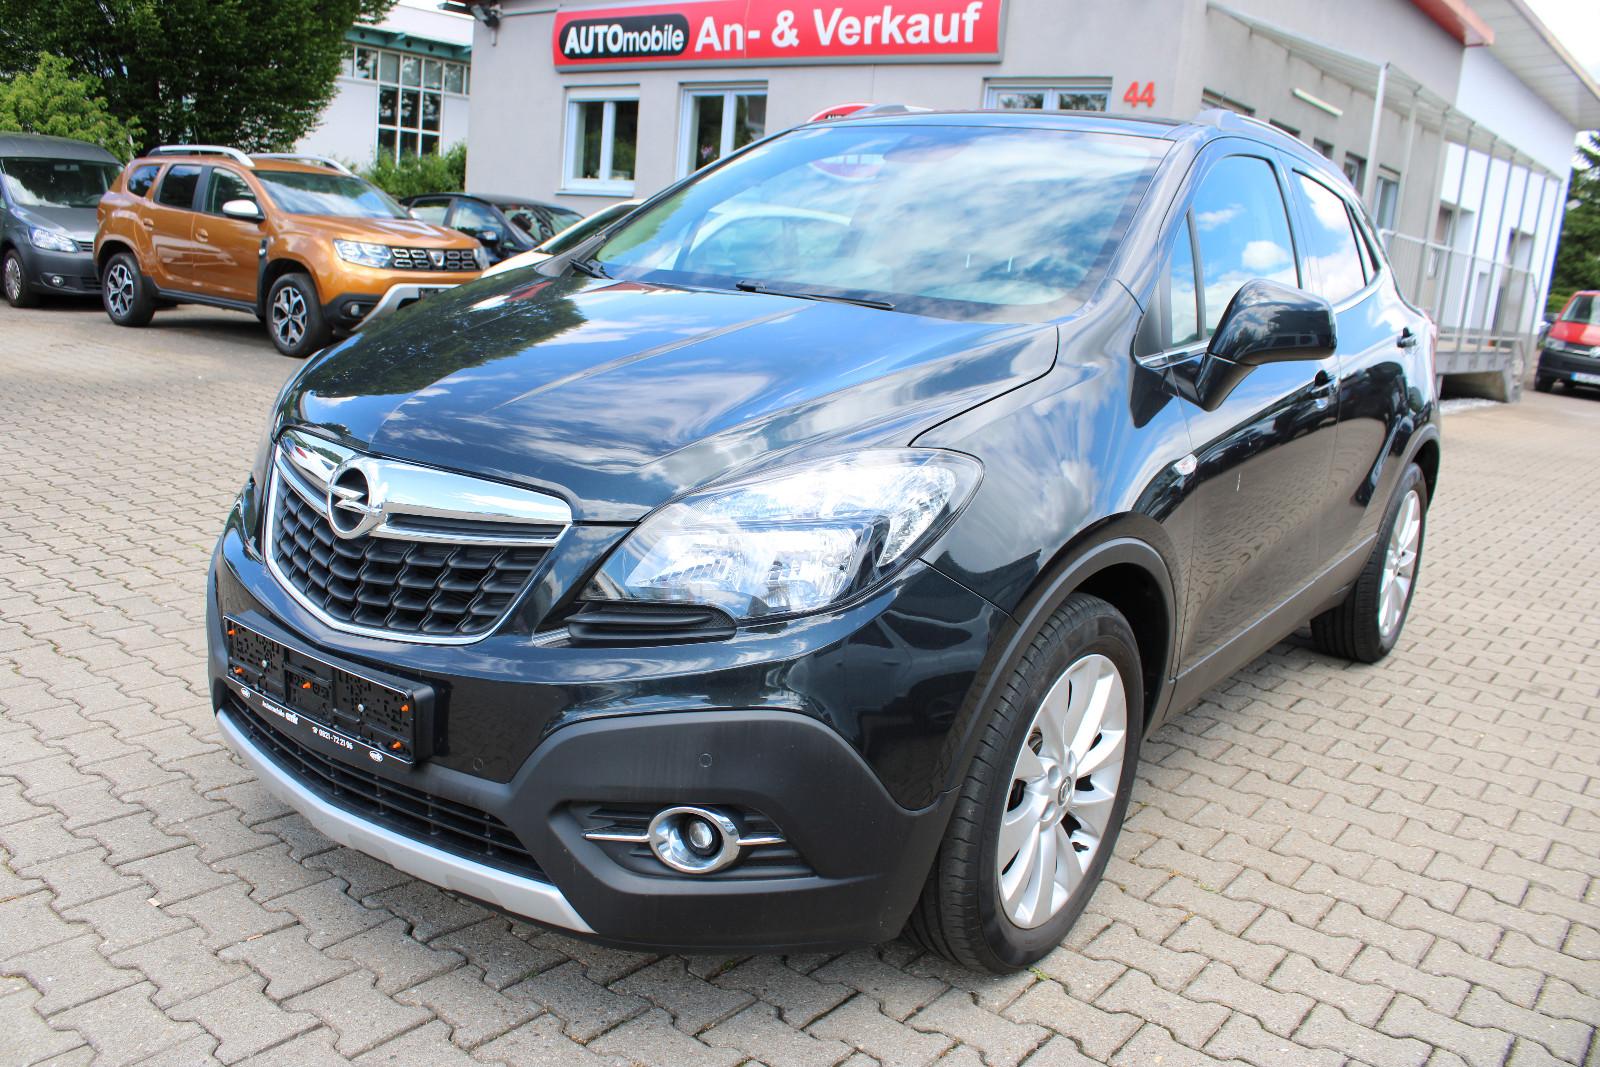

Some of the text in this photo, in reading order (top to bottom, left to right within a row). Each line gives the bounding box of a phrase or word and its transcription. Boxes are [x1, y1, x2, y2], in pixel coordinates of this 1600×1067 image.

[564, 1, 983, 55] AUTOmobile An- & Verkauf
[1123, 81, 1156, 108] 44
